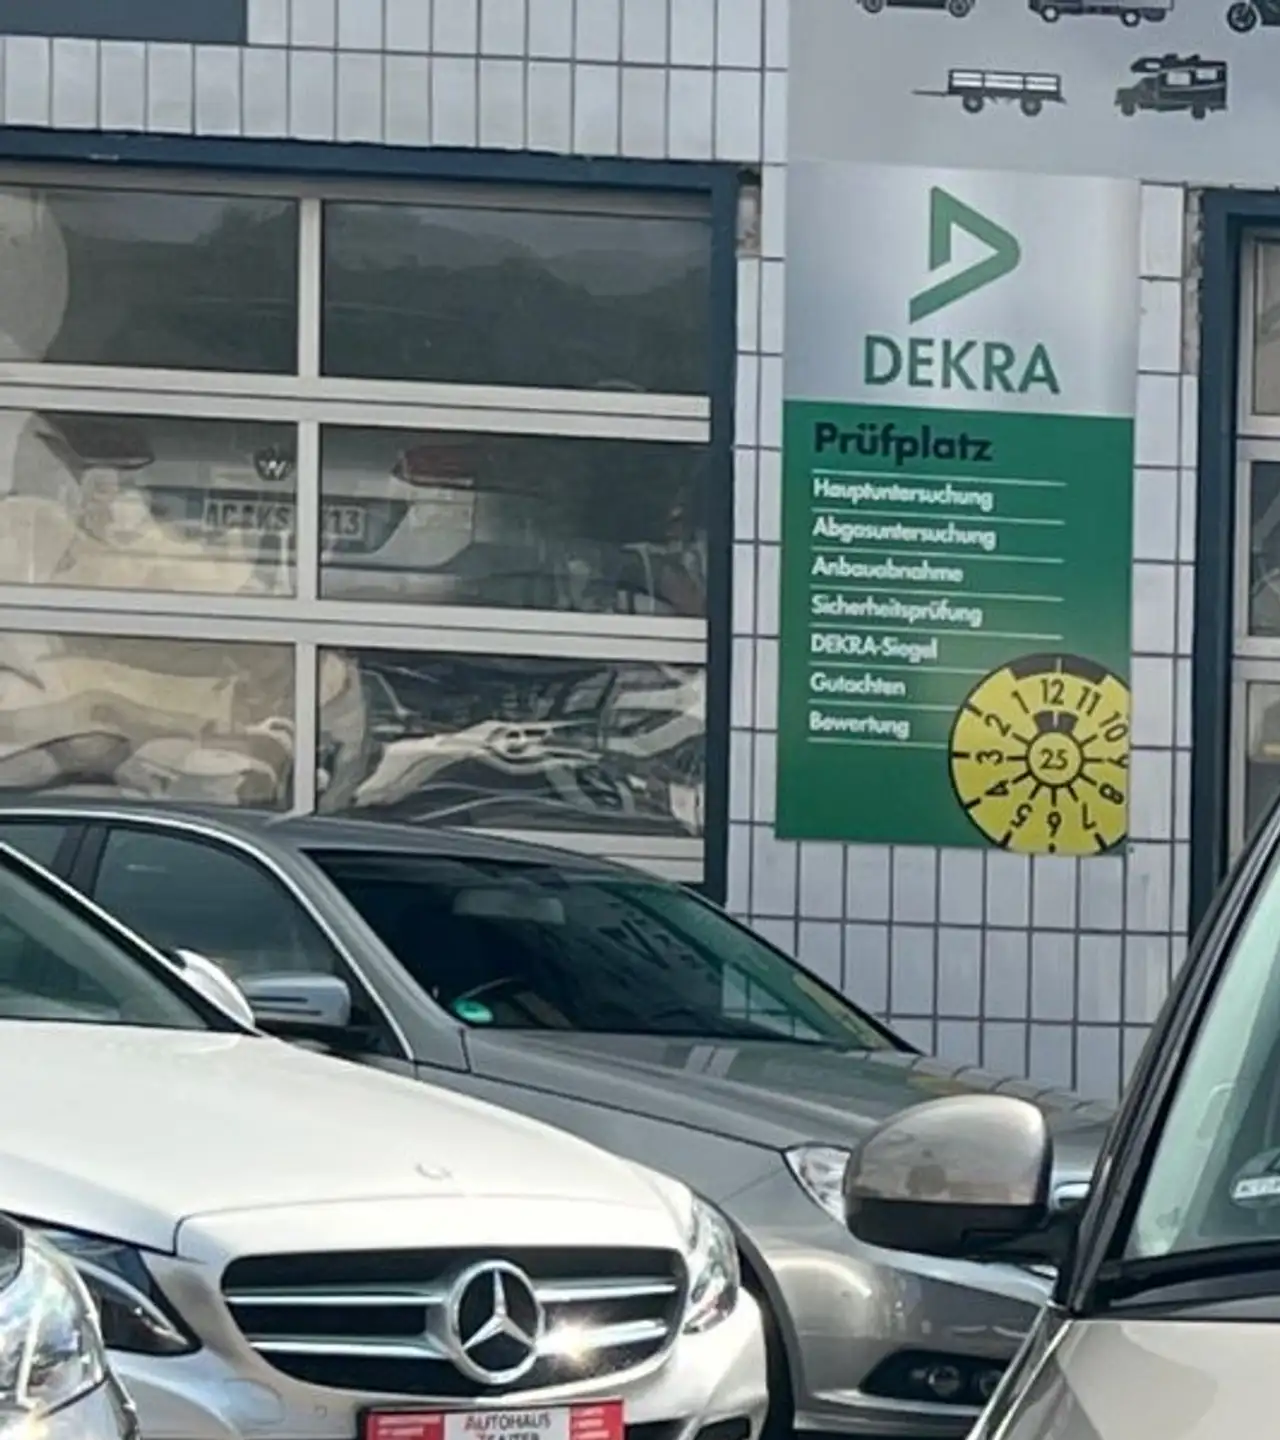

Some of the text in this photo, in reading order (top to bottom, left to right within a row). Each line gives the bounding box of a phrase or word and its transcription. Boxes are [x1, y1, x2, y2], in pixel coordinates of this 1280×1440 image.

[863, 334, 1061, 394] DEKRA
[814, 422, 994, 465] Prüfplatz
[813, 478, 994, 512] Hauptuntersuchung
[812, 516, 997, 551] Abgasuntersuchung
[811, 555, 963, 582] Anbauabnahme
[811, 594, 983, 627] Sicherheitsprüfung
[810, 633, 938, 663] DEKRA-Siegel
[809, 672, 906, 695] Gutachten
[1040, 679, 1064, 705] 12
[1011, 691, 1030, 714] 1
[1076, 687, 1102, 716] 11
[809, 711, 910, 740] Bewertung
[984, 714, 1011, 737] 2
[1099, 711, 1128, 743] 10
[975, 750, 1003, 766] 3
[1040, 749, 1068, 770] 25
[985, 780, 1009, 796] 4
[1099, 783, 1124, 805] 8
[1010, 803, 1033, 828] 5
[1047, 811, 1062, 837] 6
[1082, 803, 1097, 830] 7
